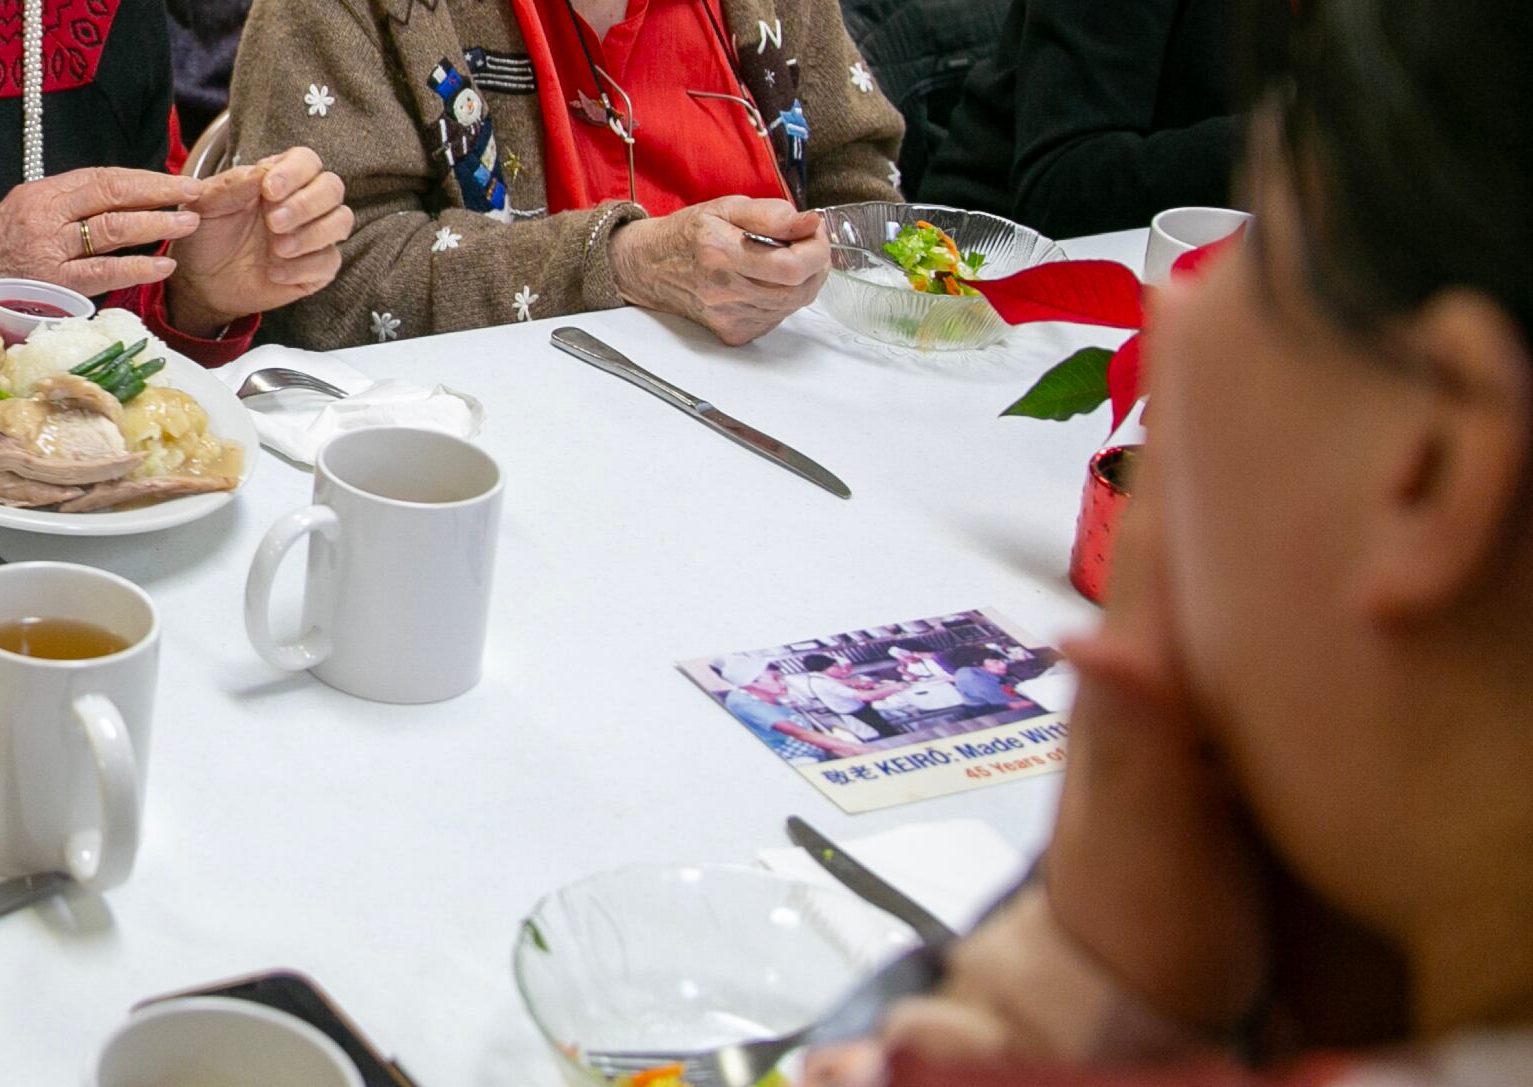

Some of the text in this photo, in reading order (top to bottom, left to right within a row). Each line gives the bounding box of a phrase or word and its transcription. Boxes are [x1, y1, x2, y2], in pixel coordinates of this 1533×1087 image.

[952, 736, 1025, 760] Made
[964, 765, 992, 779] 45
[987, 754, 1046, 774] Years
